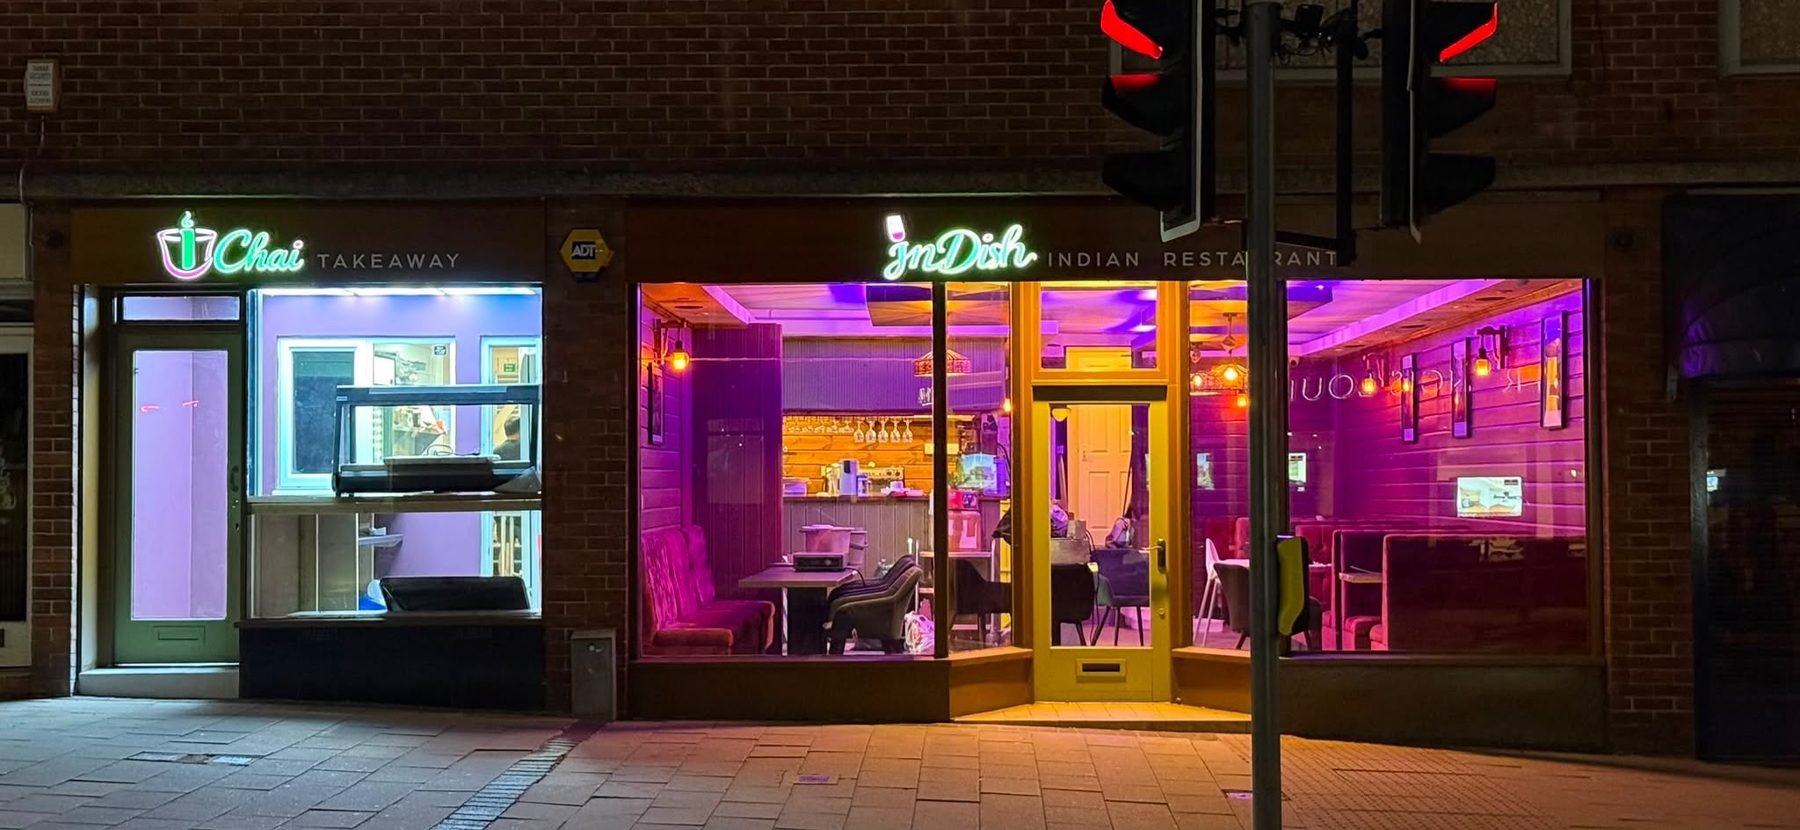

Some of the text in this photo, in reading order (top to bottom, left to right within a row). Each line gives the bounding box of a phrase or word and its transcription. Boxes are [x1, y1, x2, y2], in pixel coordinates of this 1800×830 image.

[213, 229, 459, 274] Chai TAKEAWAY
[571, 244, 597, 257] ADT
[1048, 252, 1139, 267] INDIAN
[1164, 251, 1337, 267] RESTARANT
